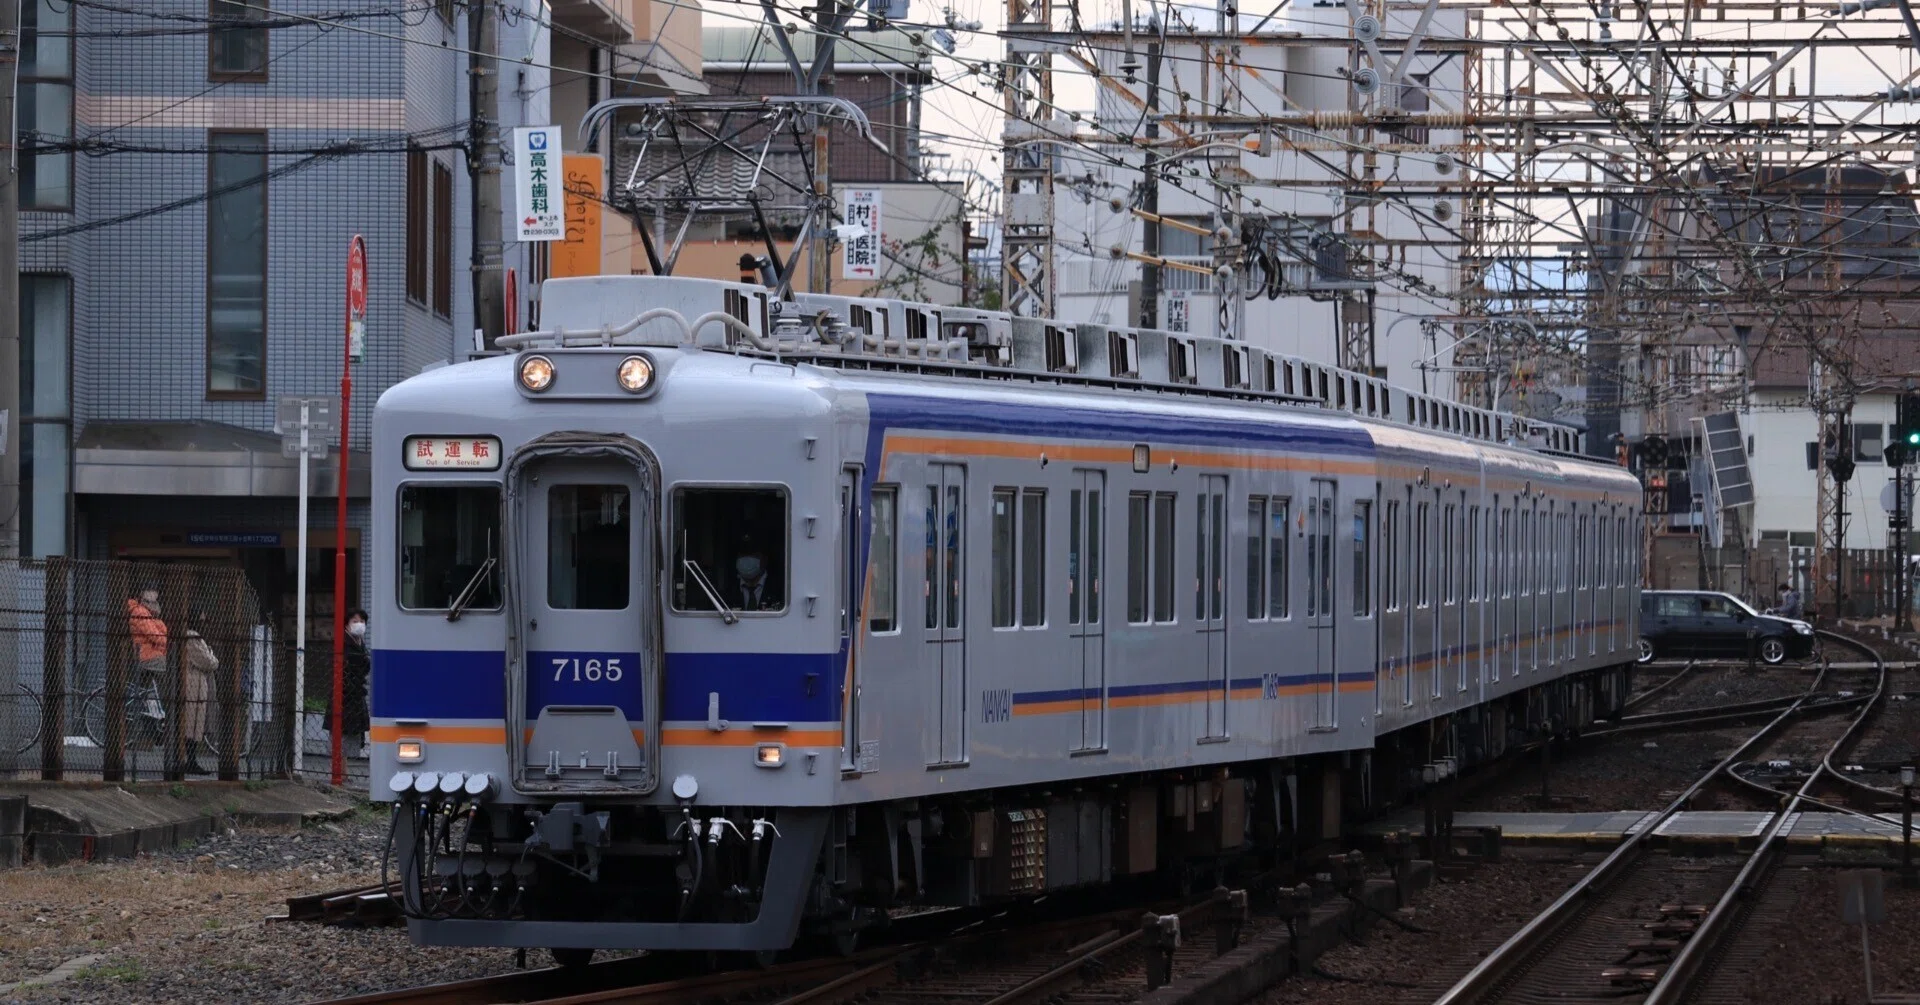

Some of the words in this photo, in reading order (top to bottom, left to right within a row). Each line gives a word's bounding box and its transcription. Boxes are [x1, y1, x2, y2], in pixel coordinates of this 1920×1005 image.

[530, 152, 548, 214] 高木歯科
[856, 204, 870, 265] 村上医院
[417, 440, 490, 458] 試運転
[552, 658, 623, 682] 7165
[981, 689, 1011, 723] NANKAI
